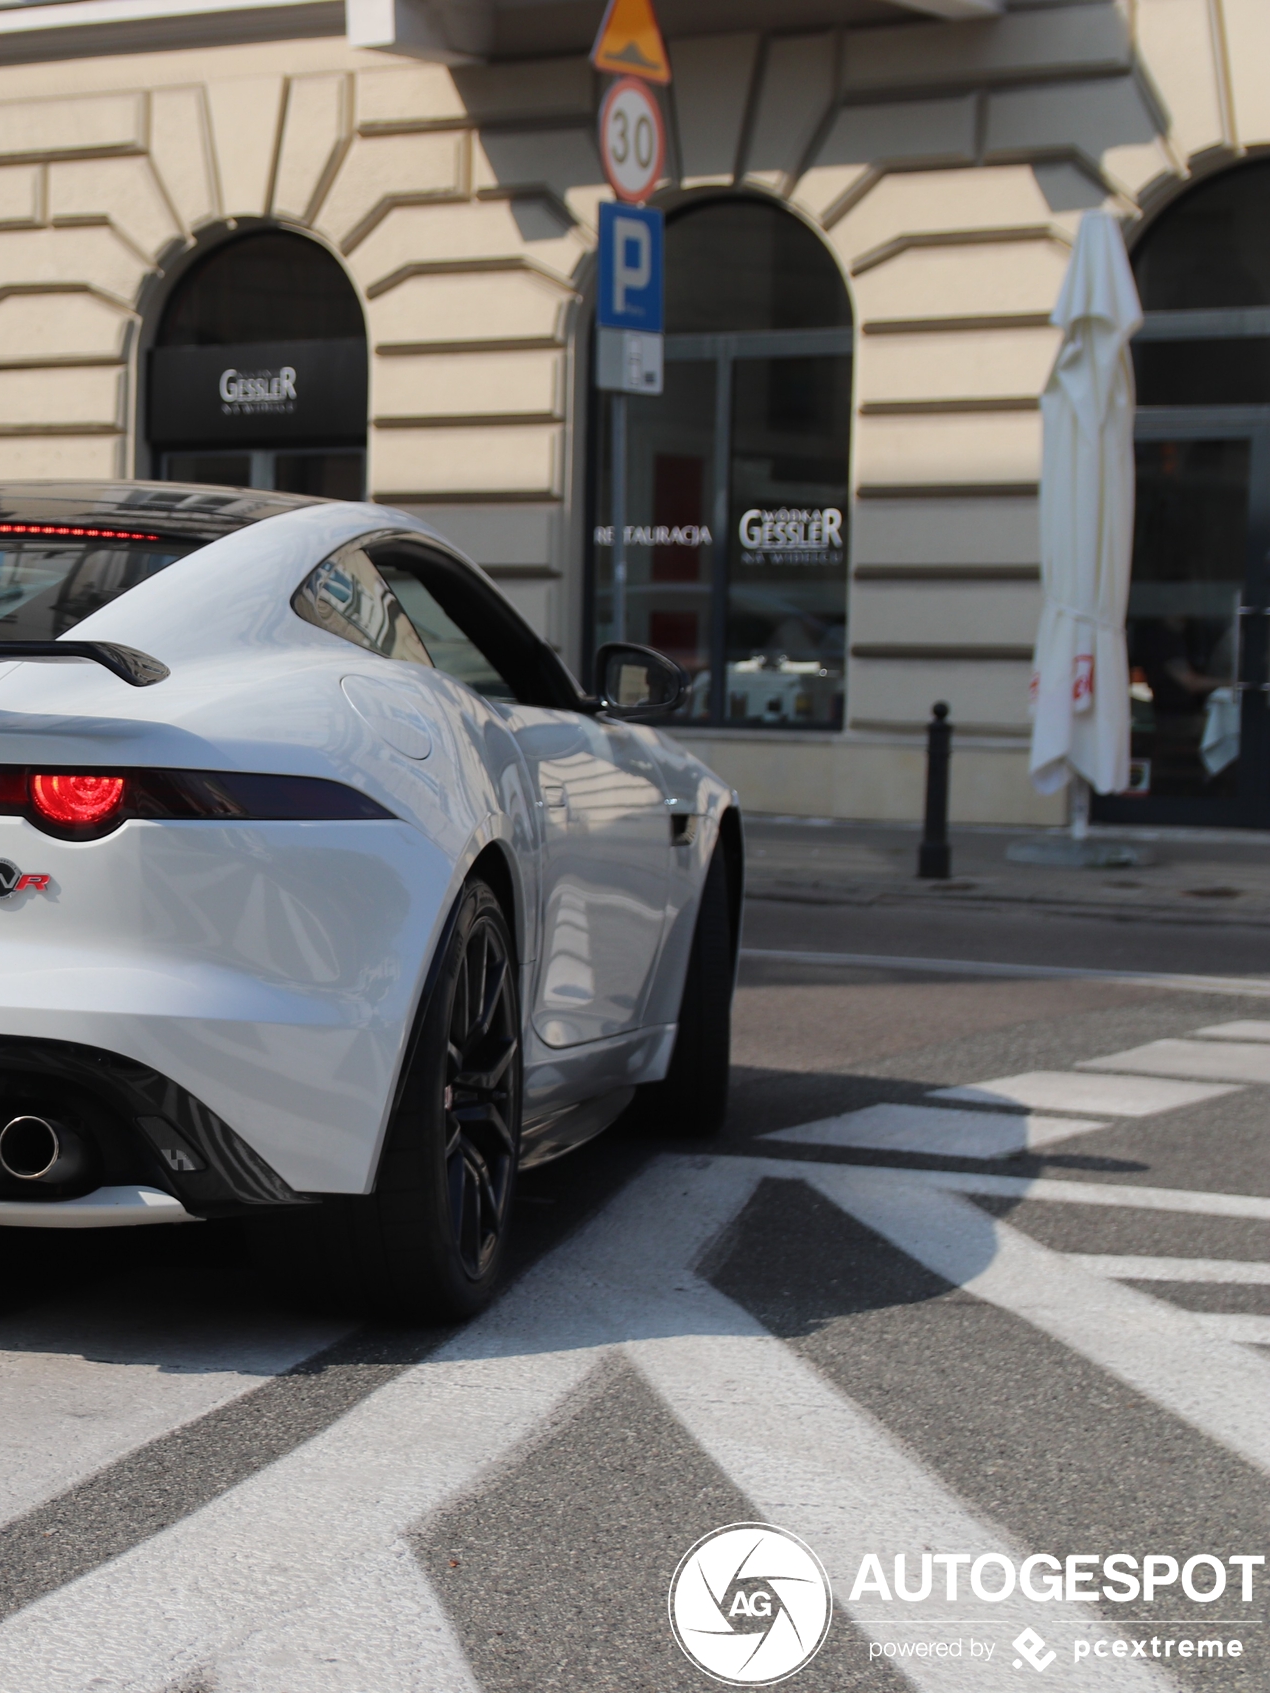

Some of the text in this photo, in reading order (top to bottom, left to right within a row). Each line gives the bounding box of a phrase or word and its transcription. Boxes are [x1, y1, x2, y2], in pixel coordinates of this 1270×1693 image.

[611, 108, 654, 170] 30
[613, 215, 652, 315] P
[593, 525, 713, 548] RETAURACJA
[739, 508, 843, 549] GESSLER
